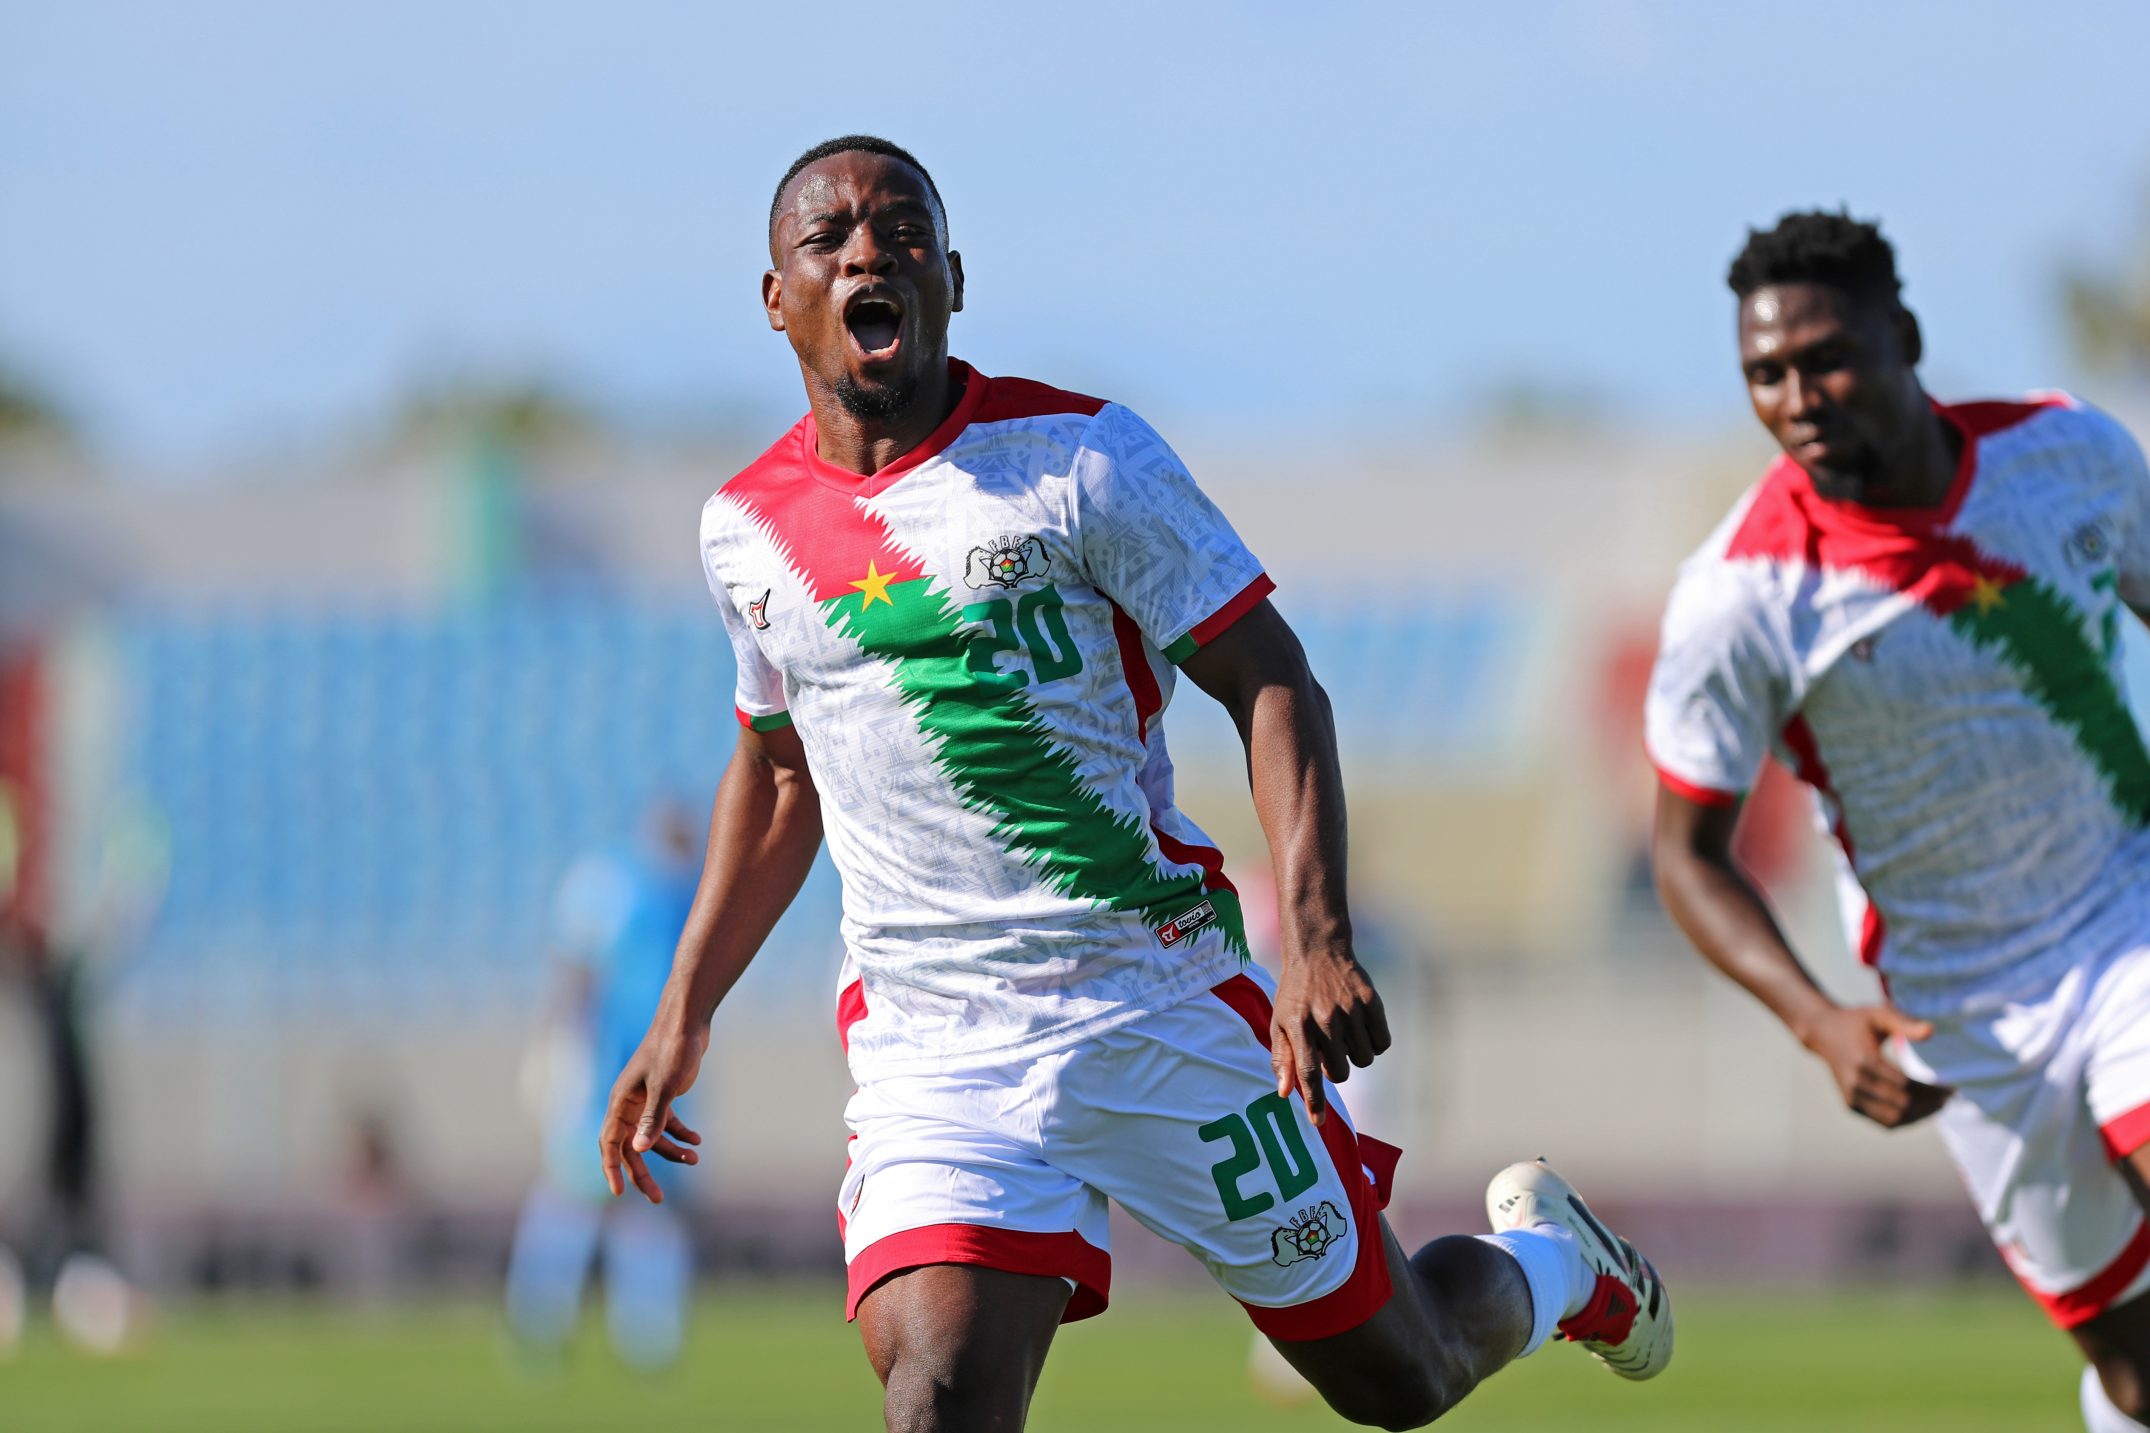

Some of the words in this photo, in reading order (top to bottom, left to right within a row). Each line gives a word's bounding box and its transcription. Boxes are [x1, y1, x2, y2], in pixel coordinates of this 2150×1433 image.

[988, 535, 1021, 552] FBF
[962, 583, 1084, 688] 20
[1198, 1090, 1319, 1222] 20
[1289, 1206, 1317, 1229] FBF
